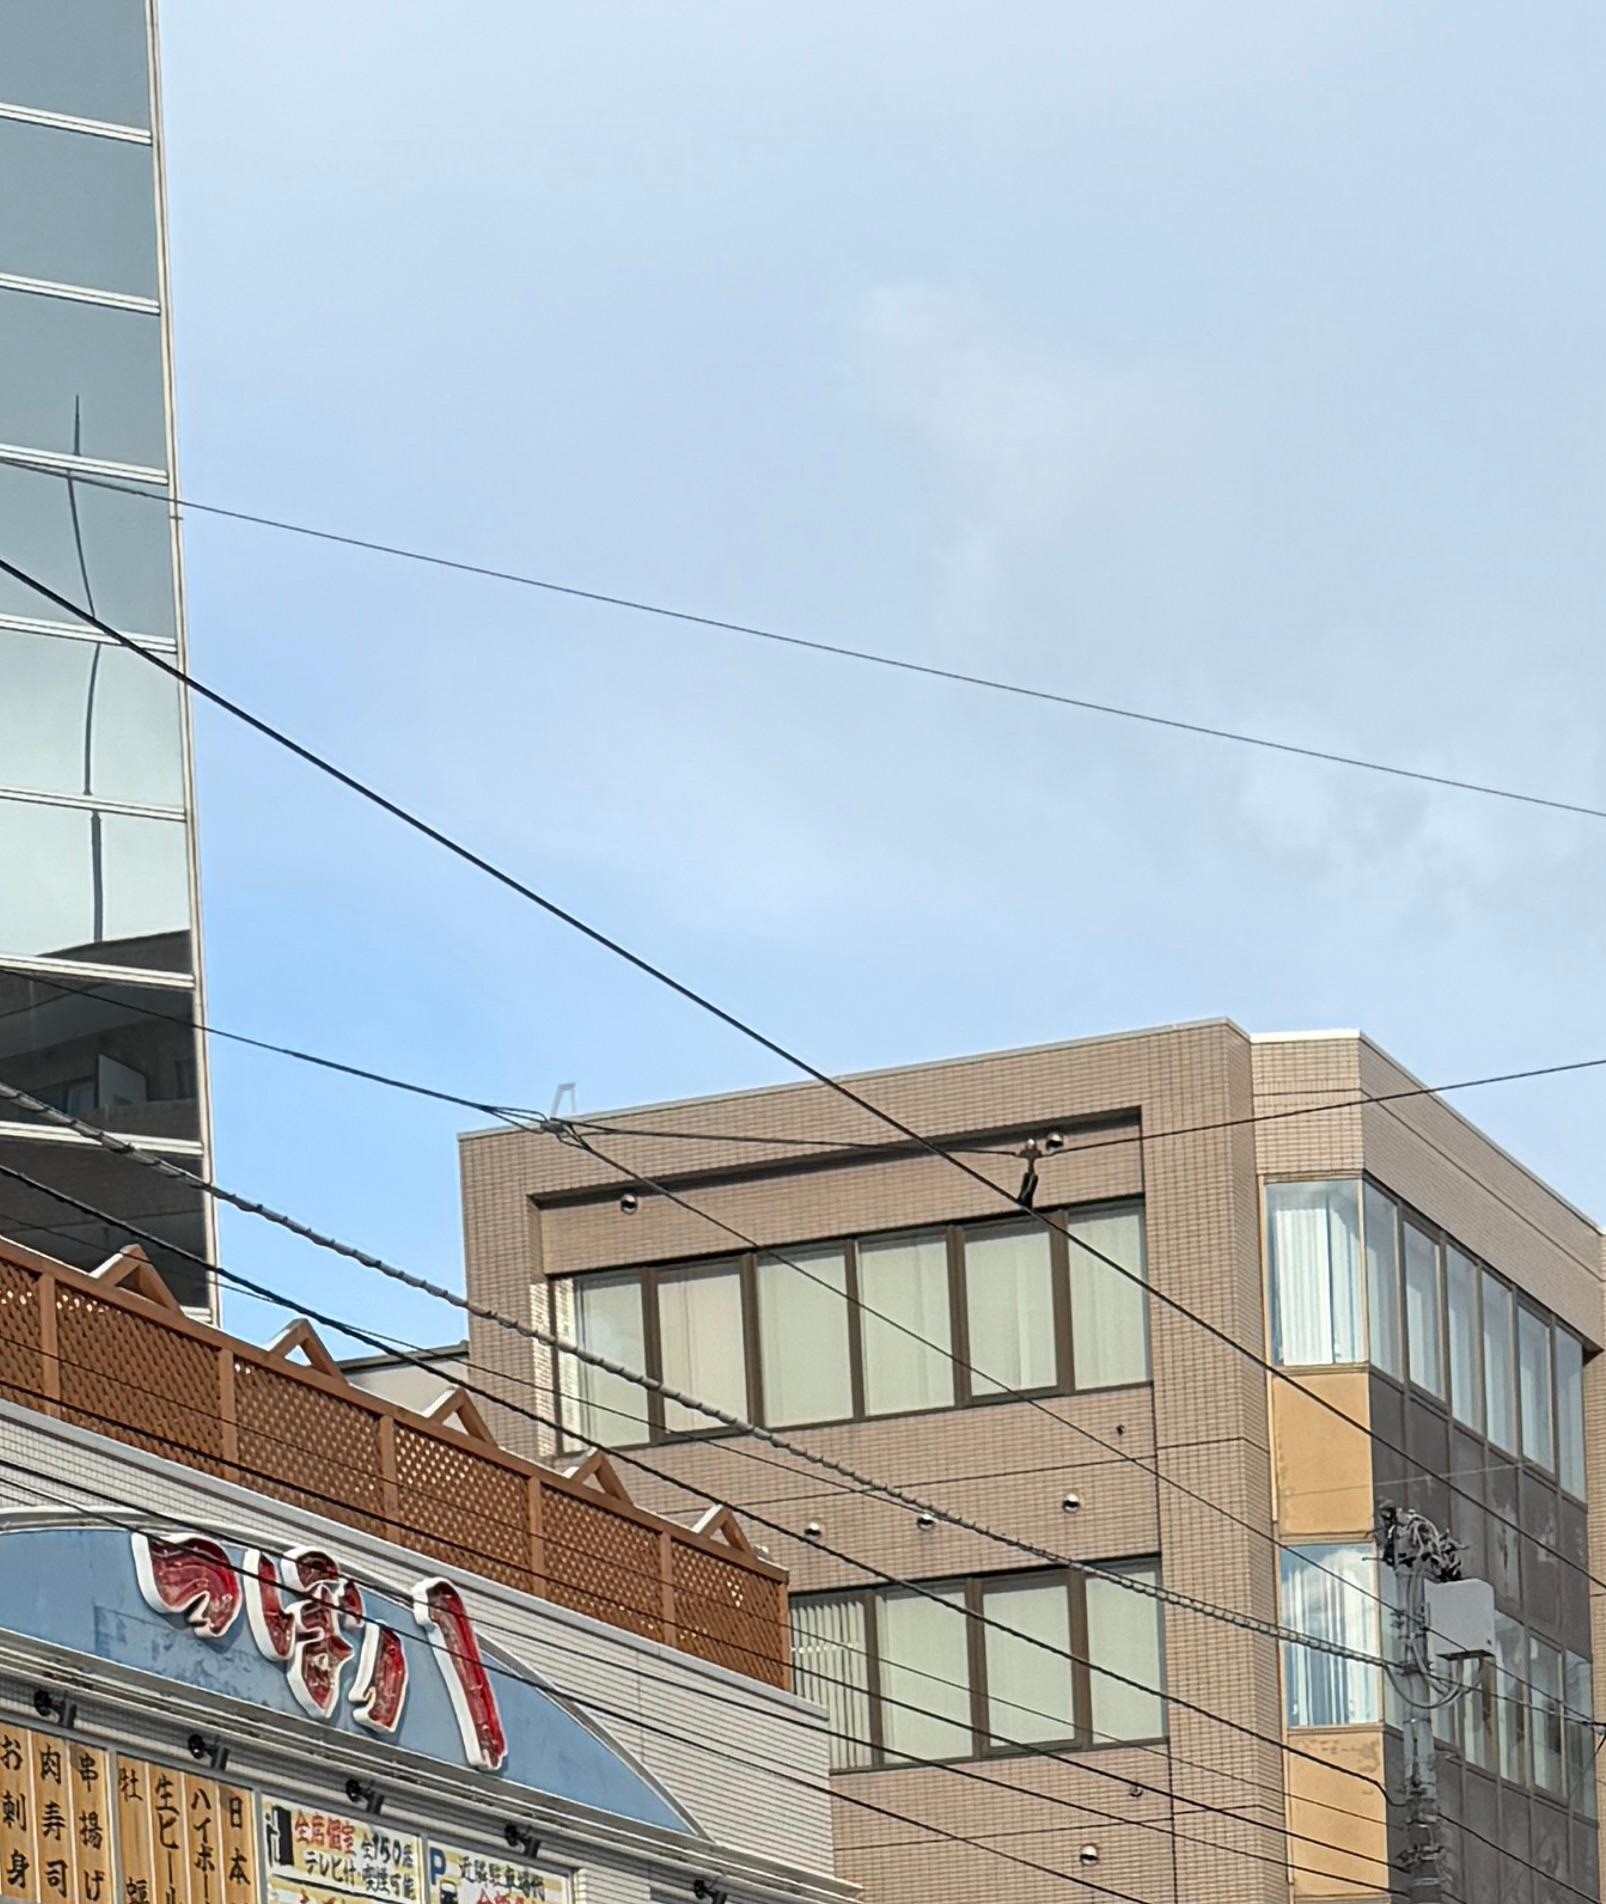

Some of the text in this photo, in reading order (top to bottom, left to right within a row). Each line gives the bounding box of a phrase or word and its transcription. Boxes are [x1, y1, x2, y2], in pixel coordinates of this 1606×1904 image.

[0, 1734, 30, 1889] お刺身
[39, 1744, 68, 1898] 肉寿司
[78, 1752, 106, 1902] 串揚げ
